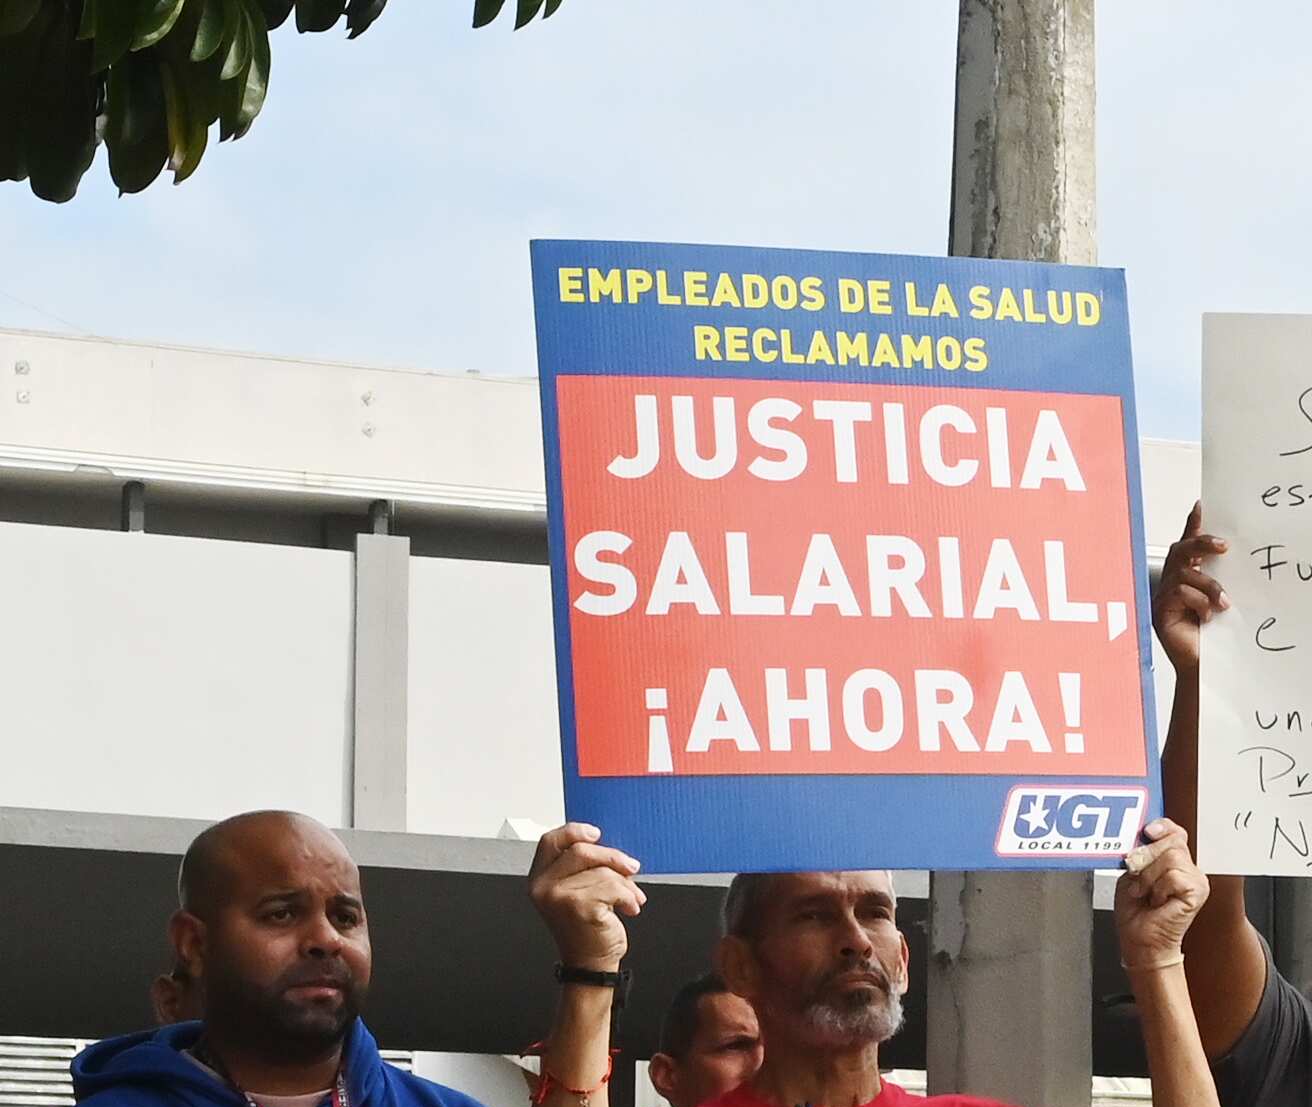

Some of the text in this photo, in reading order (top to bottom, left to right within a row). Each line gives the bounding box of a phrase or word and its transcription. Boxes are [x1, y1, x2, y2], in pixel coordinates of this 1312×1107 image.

[559, 267, 1101, 326] EMPLEADOS DE LA SALUD
[695, 326, 987, 371] RECLAMAMOS
[606, 395, 1087, 492] JUSTICIA
[573, 530, 1128, 641] SALARIAL,
[645, 668, 1085, 773] ¡AHORA!
[1013, 794, 1139, 838] UGT
[1018, 841, 1122, 850] LOCAL 1199
